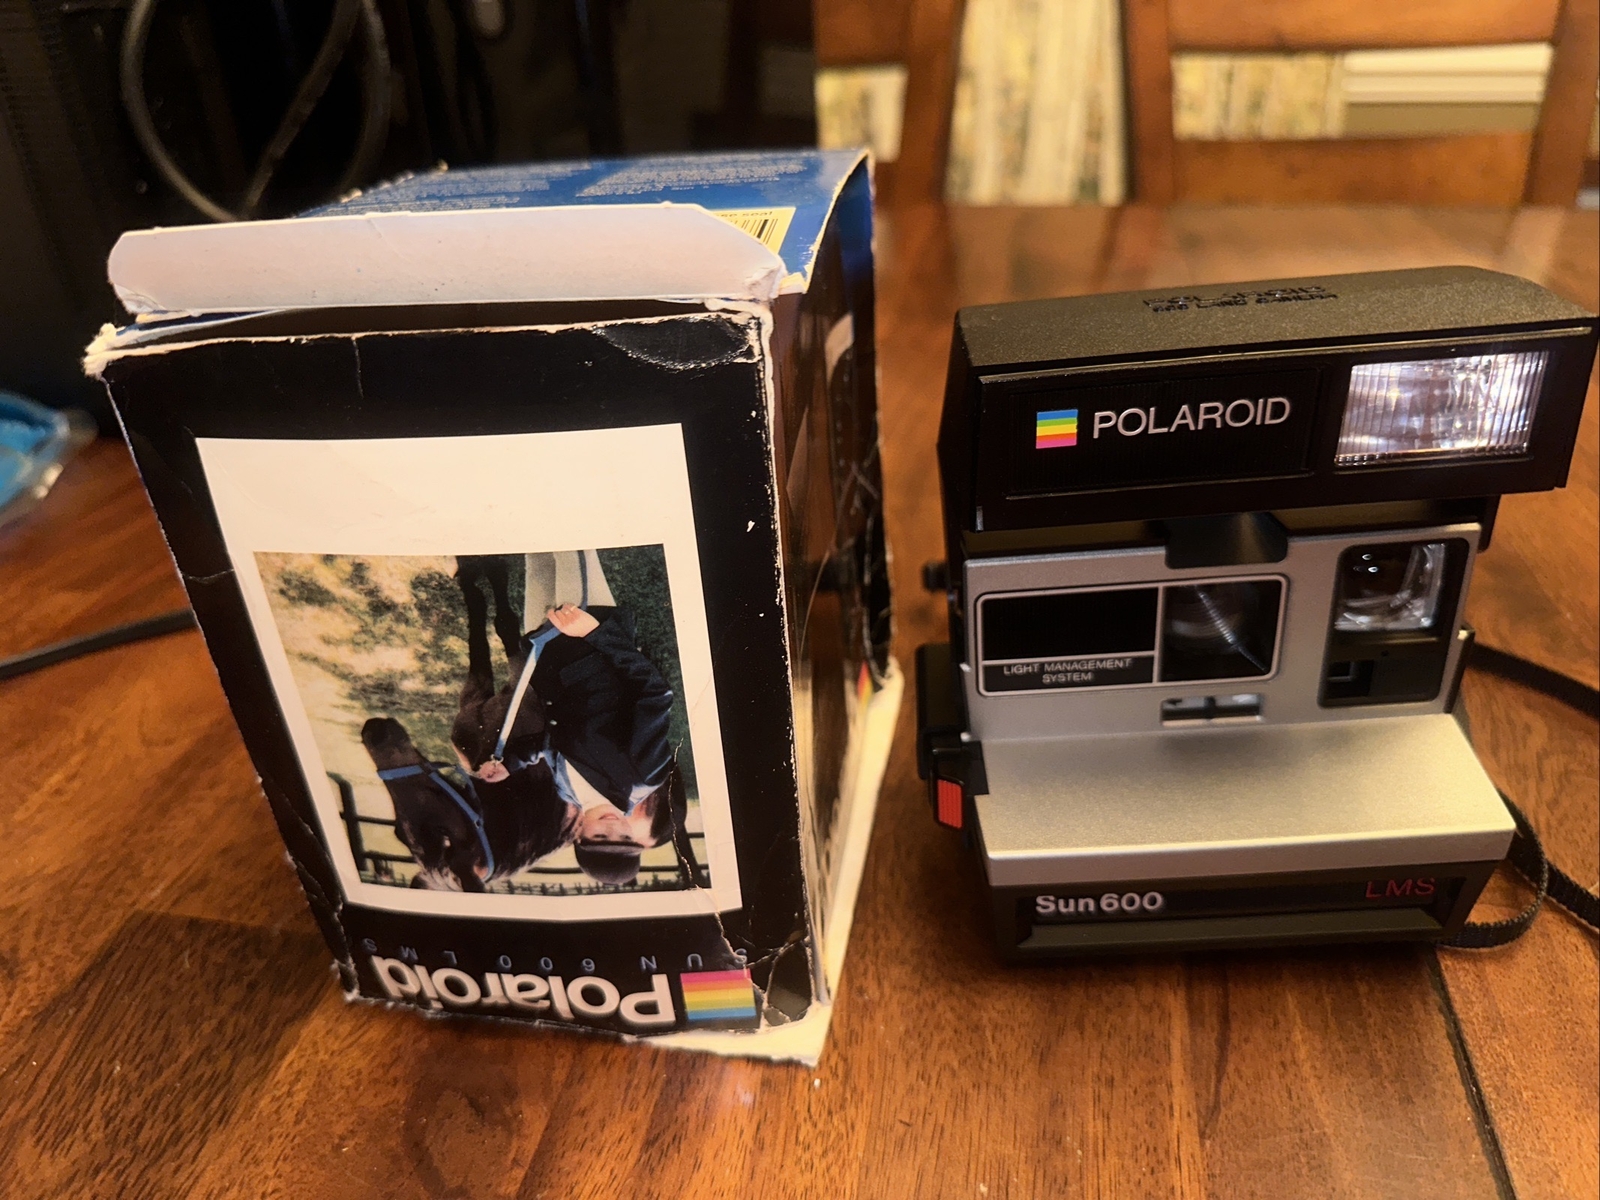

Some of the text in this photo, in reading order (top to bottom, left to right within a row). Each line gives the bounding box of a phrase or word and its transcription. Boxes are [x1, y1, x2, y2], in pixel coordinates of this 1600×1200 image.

[1143, 285, 1326, 306] POLAROID
[1196, 299, 1247, 309] LAND
[1255, 293, 1338, 304] CAMERA
[1093, 397, 1291, 439] POLAROID
[1003, 658, 1132, 675] LIGHT MANAGEMENT
[1042, 672, 1093, 684] SYSTEM
[1365, 877, 1435, 898] LMS
[362, 937, 458, 966] LMS
[498, 954, 597, 973] 600
[371, 954, 677, 1026] Polaroid
